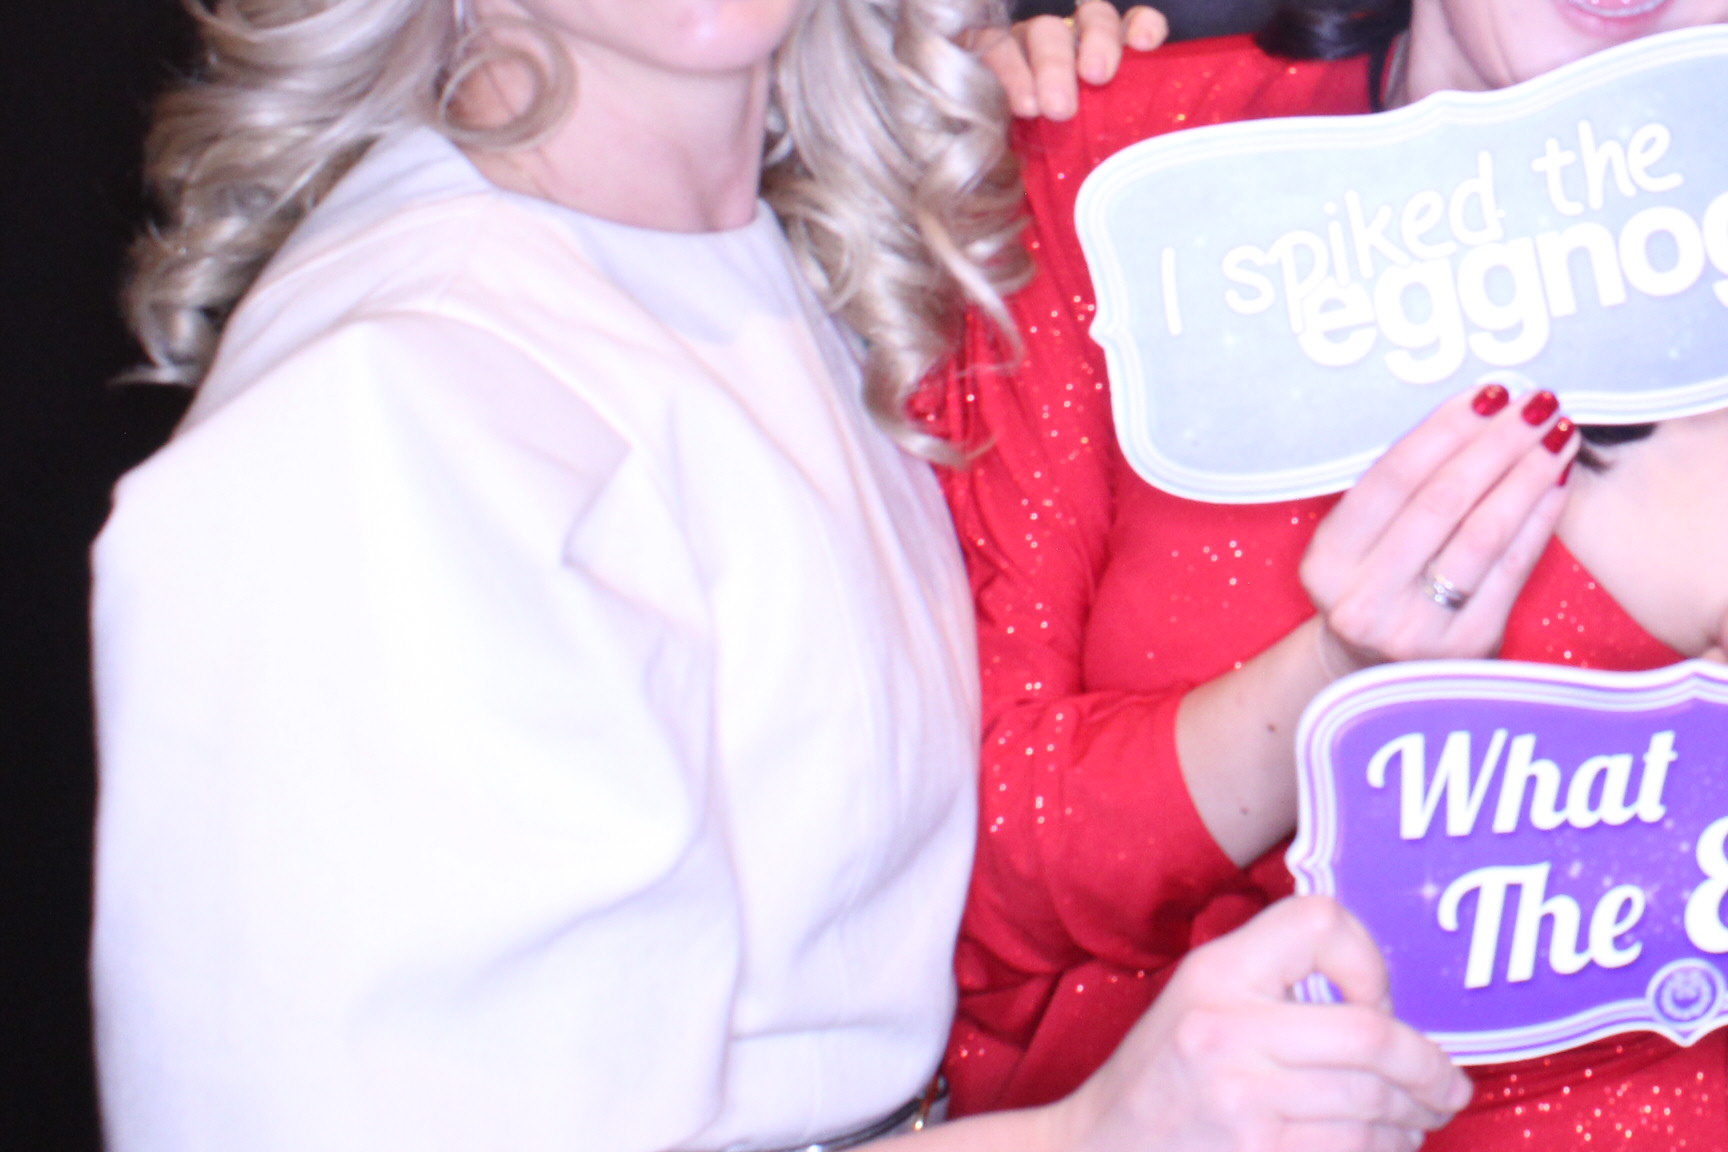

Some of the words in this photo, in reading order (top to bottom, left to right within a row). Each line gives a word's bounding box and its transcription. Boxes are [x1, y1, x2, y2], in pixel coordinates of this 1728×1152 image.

[1161, 247, 1184, 335] I
[1222, 151, 1506, 334] spiked
[1531, 120, 1683, 215] the
[1366, 729, 1678, 840] What
[1437, 862, 1647, 989] The
